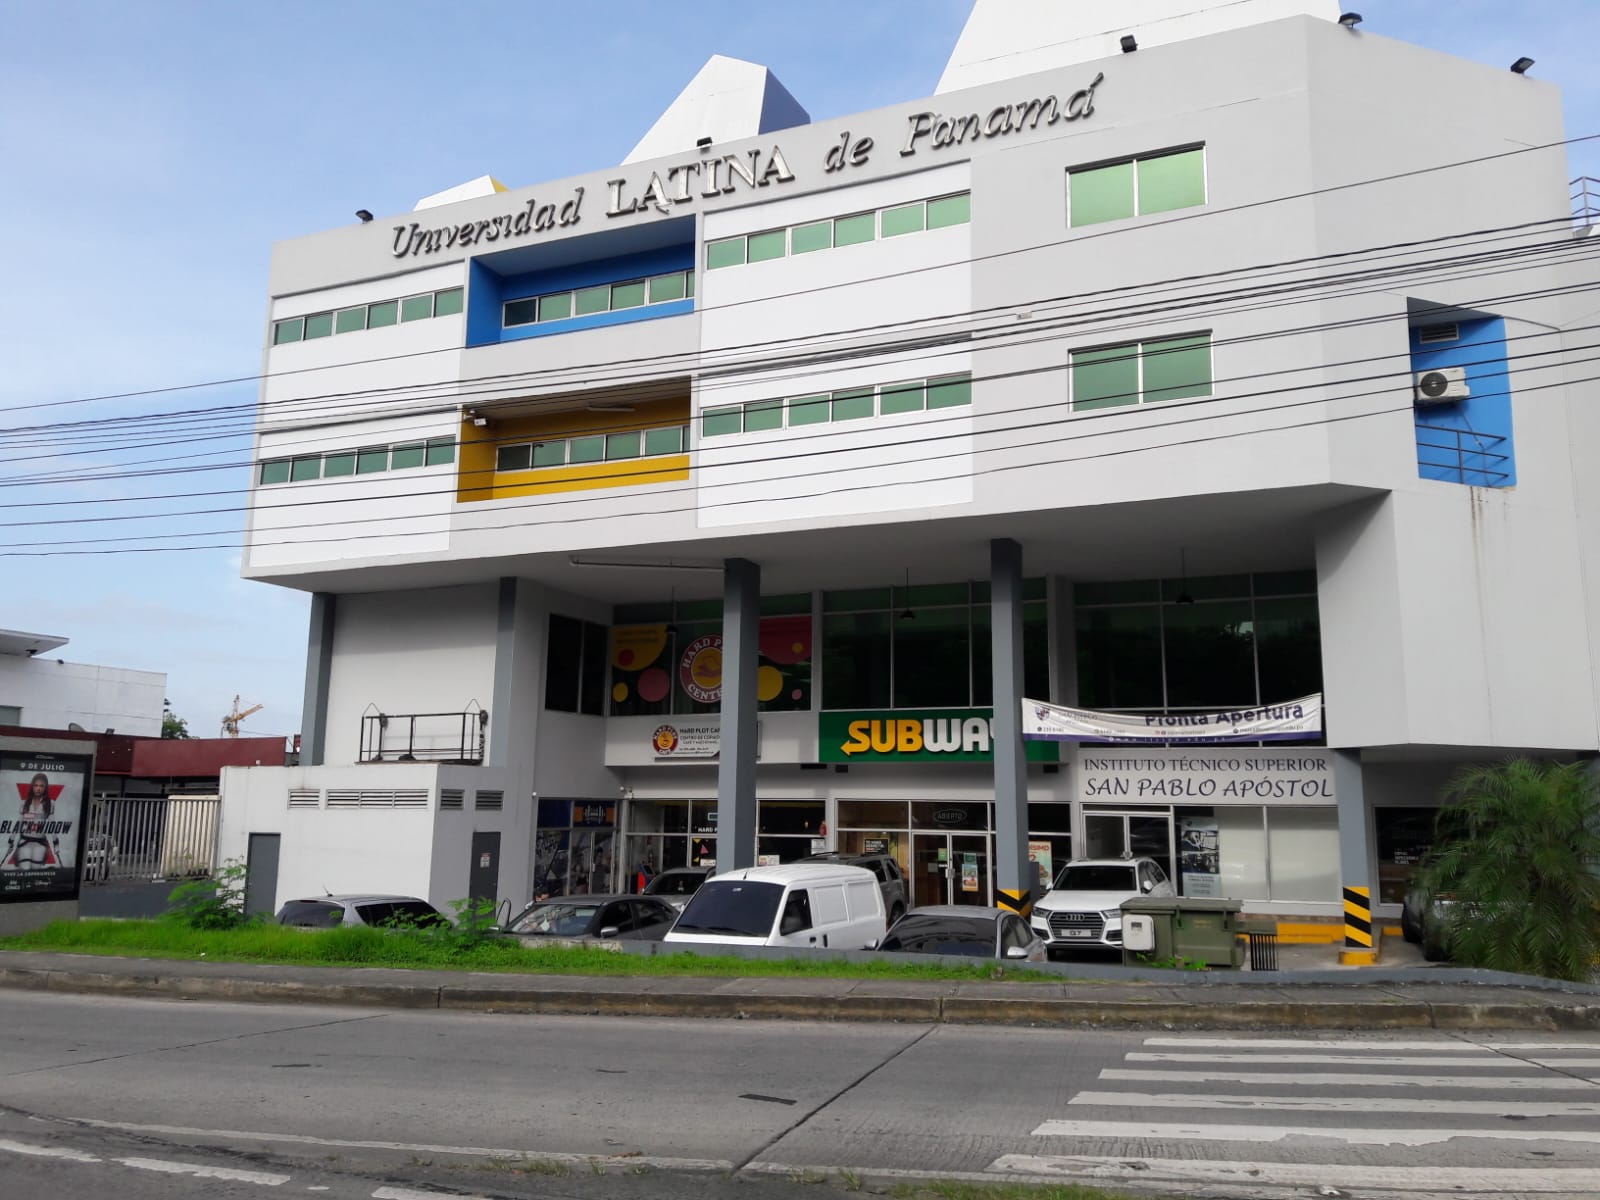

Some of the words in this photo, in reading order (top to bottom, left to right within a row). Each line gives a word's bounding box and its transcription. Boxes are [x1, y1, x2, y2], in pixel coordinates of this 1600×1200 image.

[392, 186, 585, 259] Universidad
[606, 145, 796, 218] LATINA
[823, 131, 874, 173] de
[899, 72, 1105, 158] Panamá
[682, 638, 711, 669] HARD
[687, 683, 723, 700] CENTE
[1215, 703, 1304, 726] Apertura
[840, 717, 995, 756] SUBWA
[41, 763, 65, 771] JULIO
[1083, 758, 1166, 771] INSTITUTO
[1168, 755, 1240, 771] TÉCNICO
[1244, 758, 1327, 771] SUPERIOR
[1085, 777, 1130, 796] SAN
[1137, 777, 1217, 797] PABLO
[1223, 776, 1334, 798] APÓSTOL
[0, 820, 34, 834] BLACK
[36, 821, 72, 834] WIDOW
